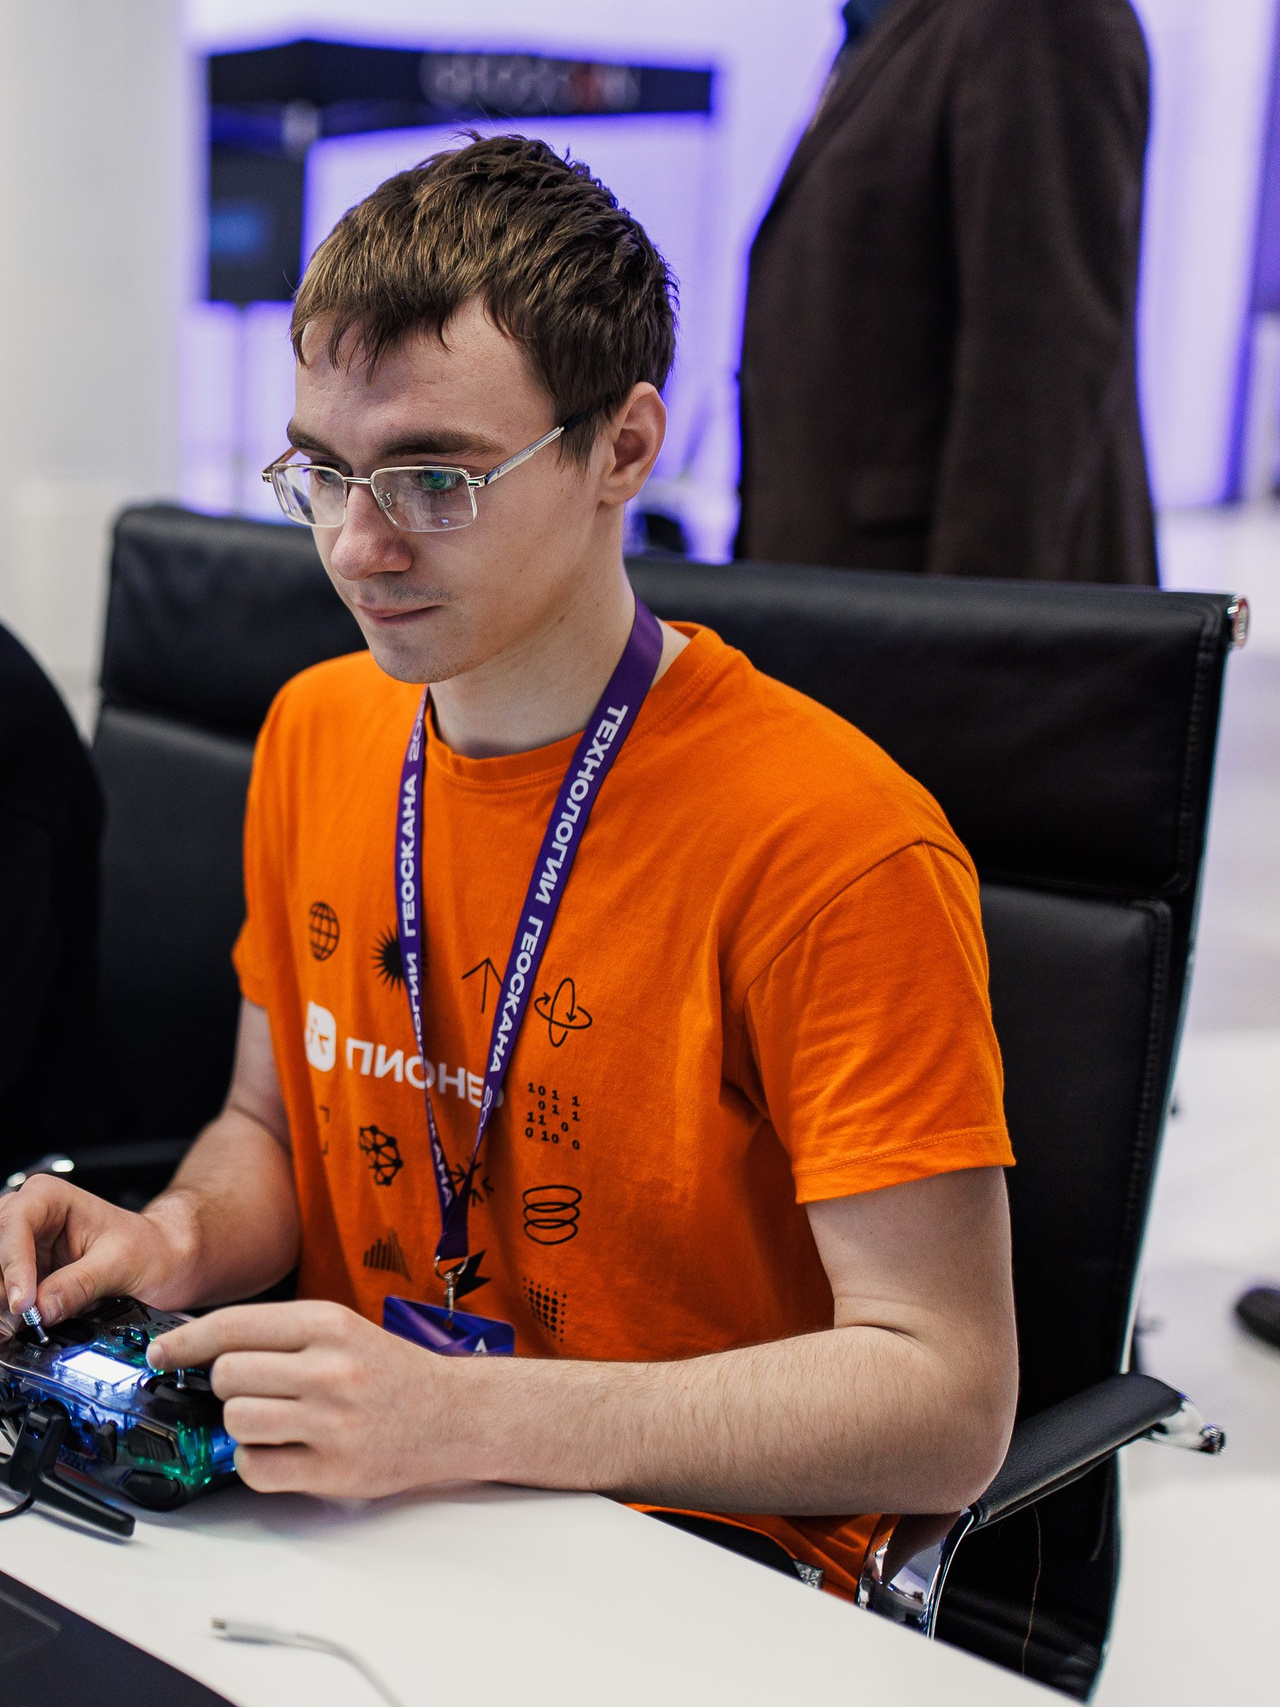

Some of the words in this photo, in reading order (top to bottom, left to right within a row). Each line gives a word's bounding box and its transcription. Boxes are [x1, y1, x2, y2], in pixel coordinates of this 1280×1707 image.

[400, 773, 418, 938] ГЕОСКАНА
[535, 704, 629, 905] ТЕХНОЛОГИИ
[489, 915, 544, 1073] ГЕОСКАНА
